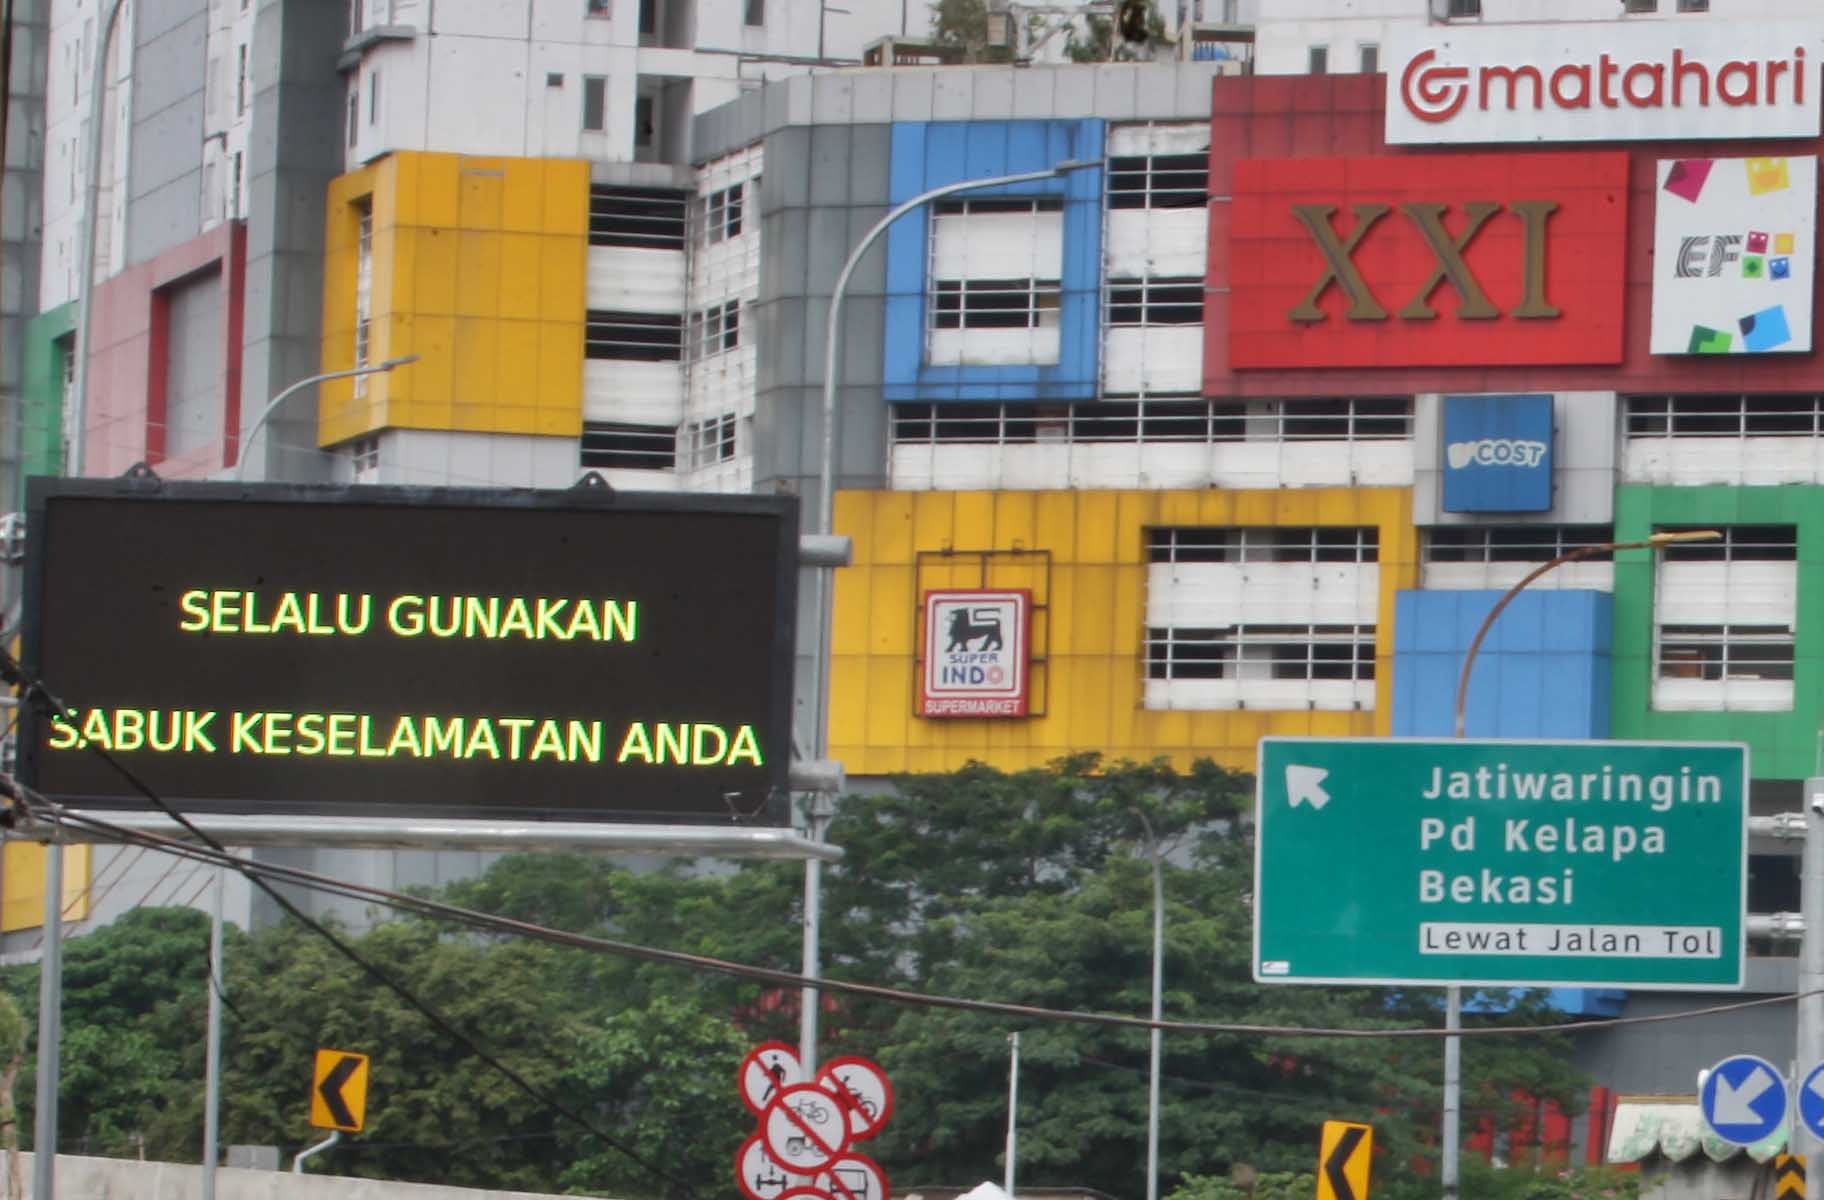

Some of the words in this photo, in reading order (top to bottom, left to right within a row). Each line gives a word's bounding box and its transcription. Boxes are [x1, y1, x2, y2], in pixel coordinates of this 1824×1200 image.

[1479, 47, 1806, 109] matahari
[1287, 201, 1562, 322] XXI
[1674, 234, 1743, 278] EF
[180, 588, 371, 637] SELALU
[388, 594, 639, 642] GUNAKAN
[942, 665, 1005, 686] INDO
[949, 653, 999, 664] SUPER
[925, 699, 1022, 714] SUPERMARKET
[48, 707, 217, 753] SABUK
[231, 711, 604, 764] KESELAMATAN
[619, 721, 764, 767] ANDA
[1422, 763, 1722, 813] Jatiwaringin
[1421, 818, 1476, 853] Pd
[1504, 819, 1667, 863] Kelapa
[1420, 868, 1575, 905] Bekasi
[1425, 926, 1527, 952] Lewat
[1548, 927, 1642, 955] Jalan
[1663, 929, 1716, 956] Tol
